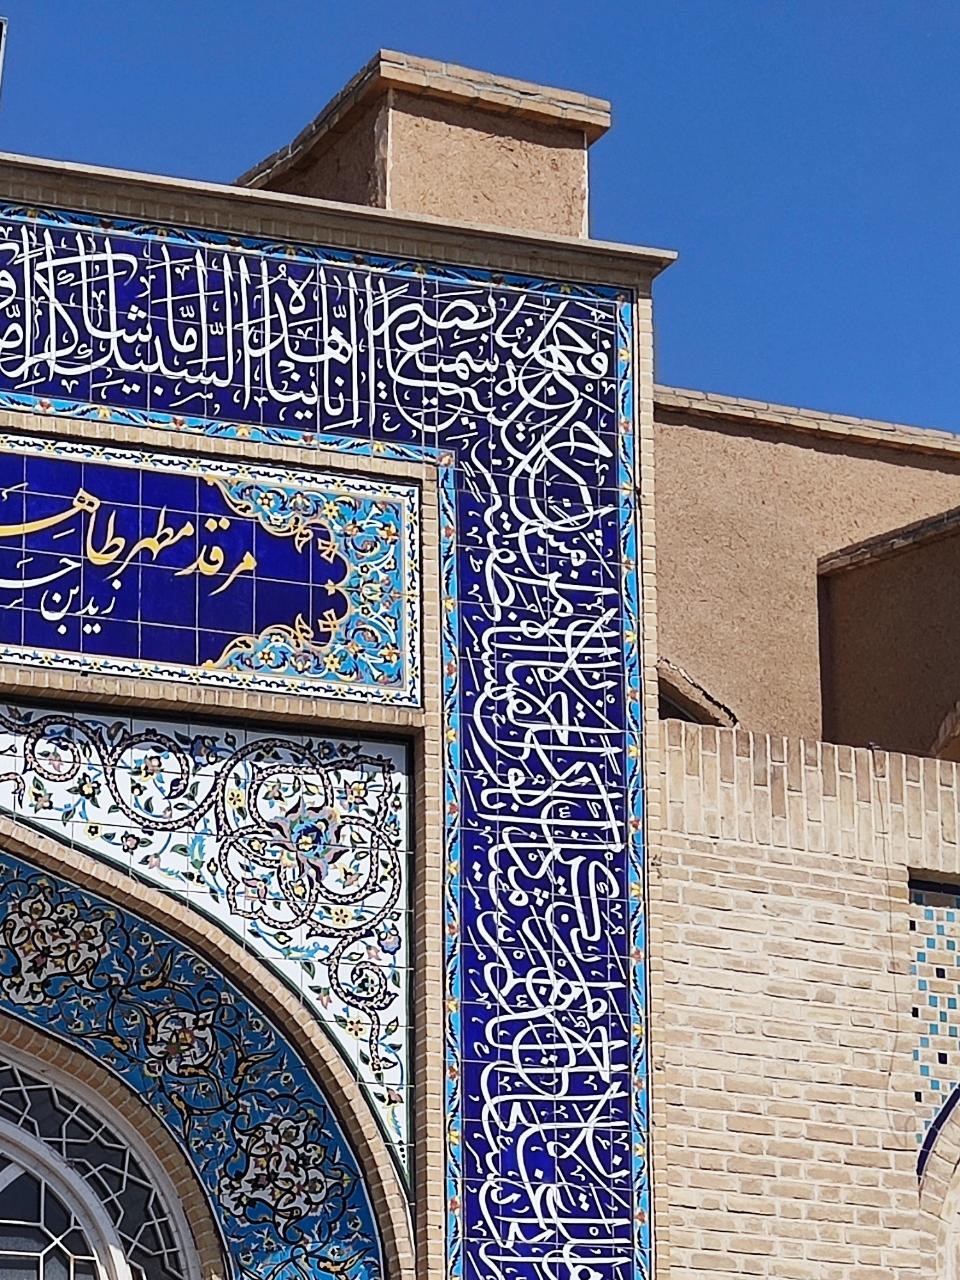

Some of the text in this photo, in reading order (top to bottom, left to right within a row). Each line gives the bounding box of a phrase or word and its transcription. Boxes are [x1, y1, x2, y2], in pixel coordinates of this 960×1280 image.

[105, 505, 195, 581] مطهر
[174, 516, 257, 596] مرقد
[41, 585, 79, 634] بن
[77, 579, 122, 634] زید
